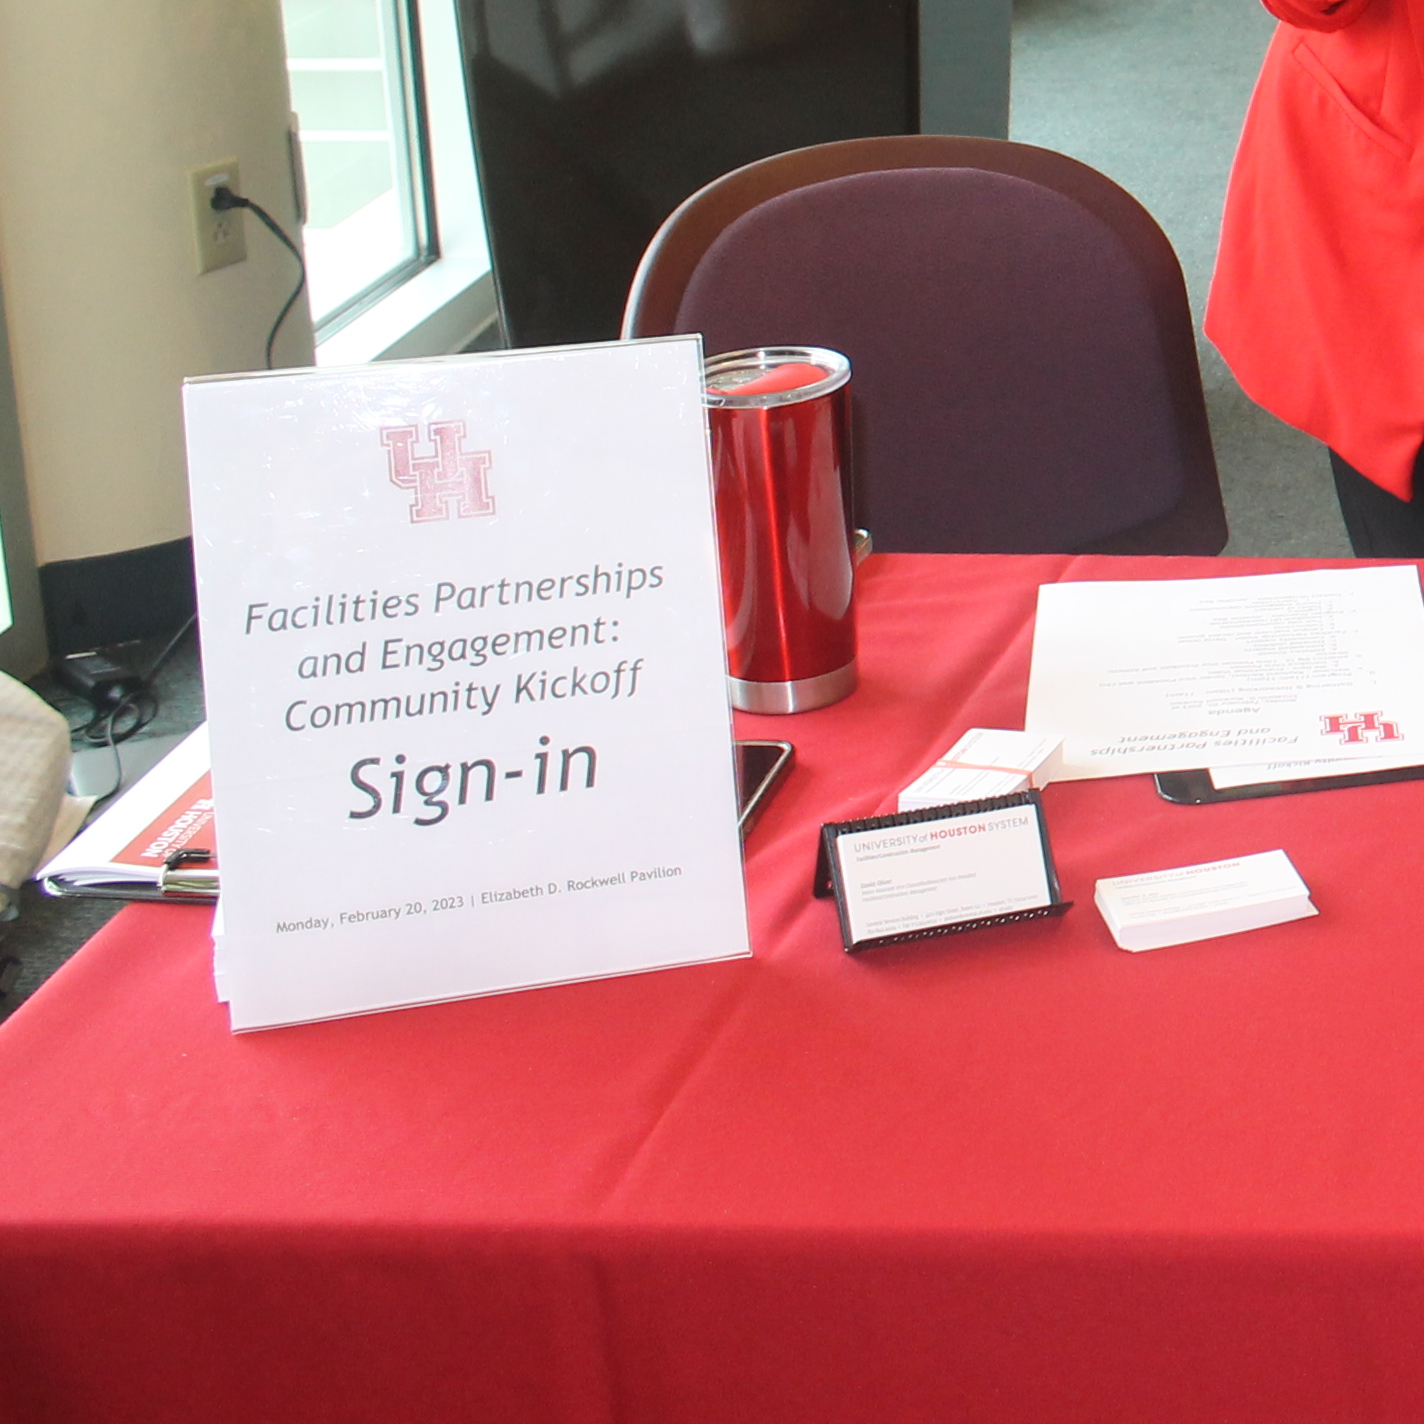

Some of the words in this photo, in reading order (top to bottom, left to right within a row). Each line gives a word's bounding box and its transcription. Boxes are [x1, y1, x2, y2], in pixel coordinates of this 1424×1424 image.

[378, 420, 497, 524] UH
[245, 591, 420, 635] Facilities
[433, 561, 664, 615] Partnerships
[298, 634, 366, 679] and
[380, 615, 620, 675] Engagement:
[285, 678, 501, 733] Community
[513, 659, 645, 704] Kickoff
[1207, 706, 1261, 716] Agenda
[1118, 728, 1232, 745] Engagement
[1213, 735, 1299, 750] Facilities
[1238, 726, 1271, 738] and
[1318, 710, 1405, 746] UH
[1090, 740, 1208, 758] Partnerships
[348, 735, 599, 826] Sign-in
[141, 810, 202, 858] HOUSTON
[854, 833, 919, 853] UNIVERSITY
[919, 833, 928, 843] of
[930, 823, 986, 841] HOUSTON
[988, 816, 1029, 833] SYSTEM
[1186, 861, 1241, 875] HOUSTON
[276, 915, 334, 935] Monday,
[339, 904, 402, 927] February
[405, 901, 427, 918] 20,
[429, 896, 465, 911] 2023
[480, 882, 544, 905] Elizabeth
[548, 881, 562, 895] D.
[567, 871, 626, 894] Rockwell
[630, 864, 682, 884] Pavilion
